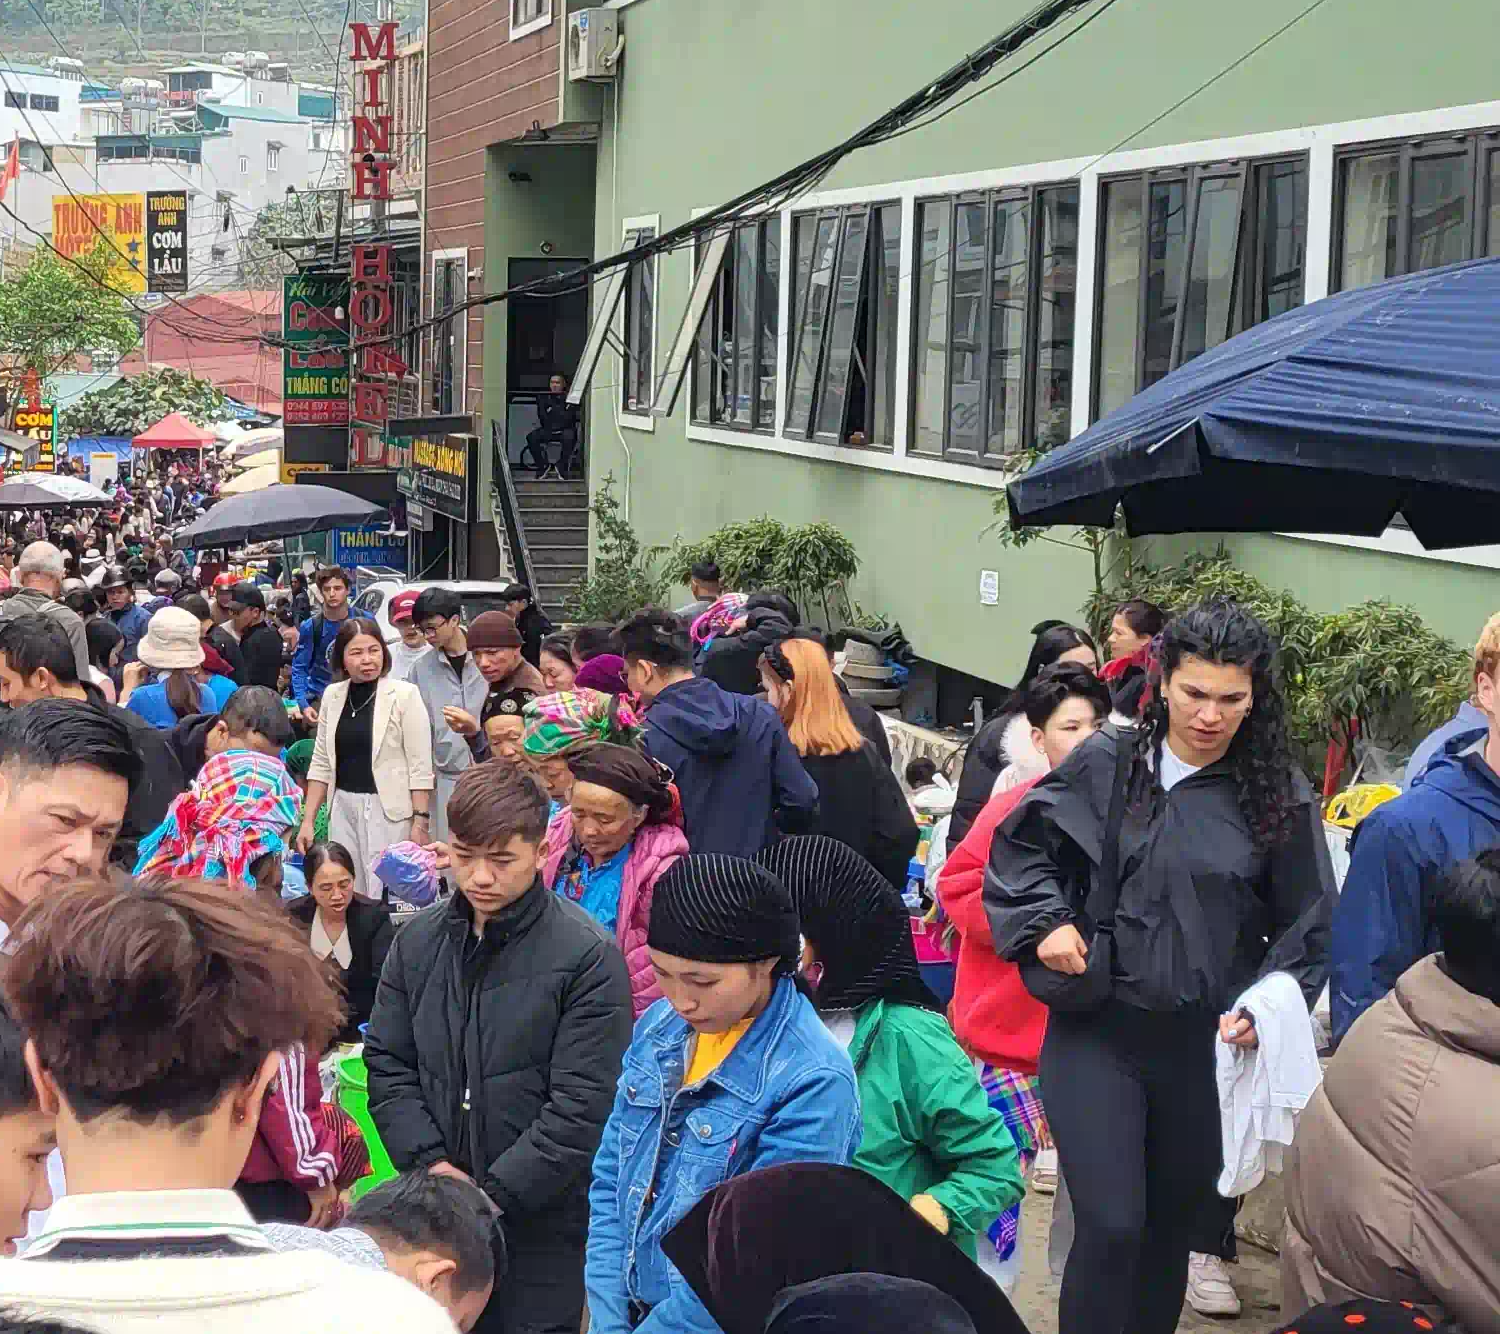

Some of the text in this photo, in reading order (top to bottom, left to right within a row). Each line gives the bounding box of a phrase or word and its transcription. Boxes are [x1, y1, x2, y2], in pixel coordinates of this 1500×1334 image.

[349, 21, 400, 200] MINH
[115, 202, 142, 235] ANH
[157, 211, 178, 226] ANH
[152, 229, 183, 249] CƠM
[153, 249, 183, 275] LẨU
[15, 411, 53, 427] CƠM
